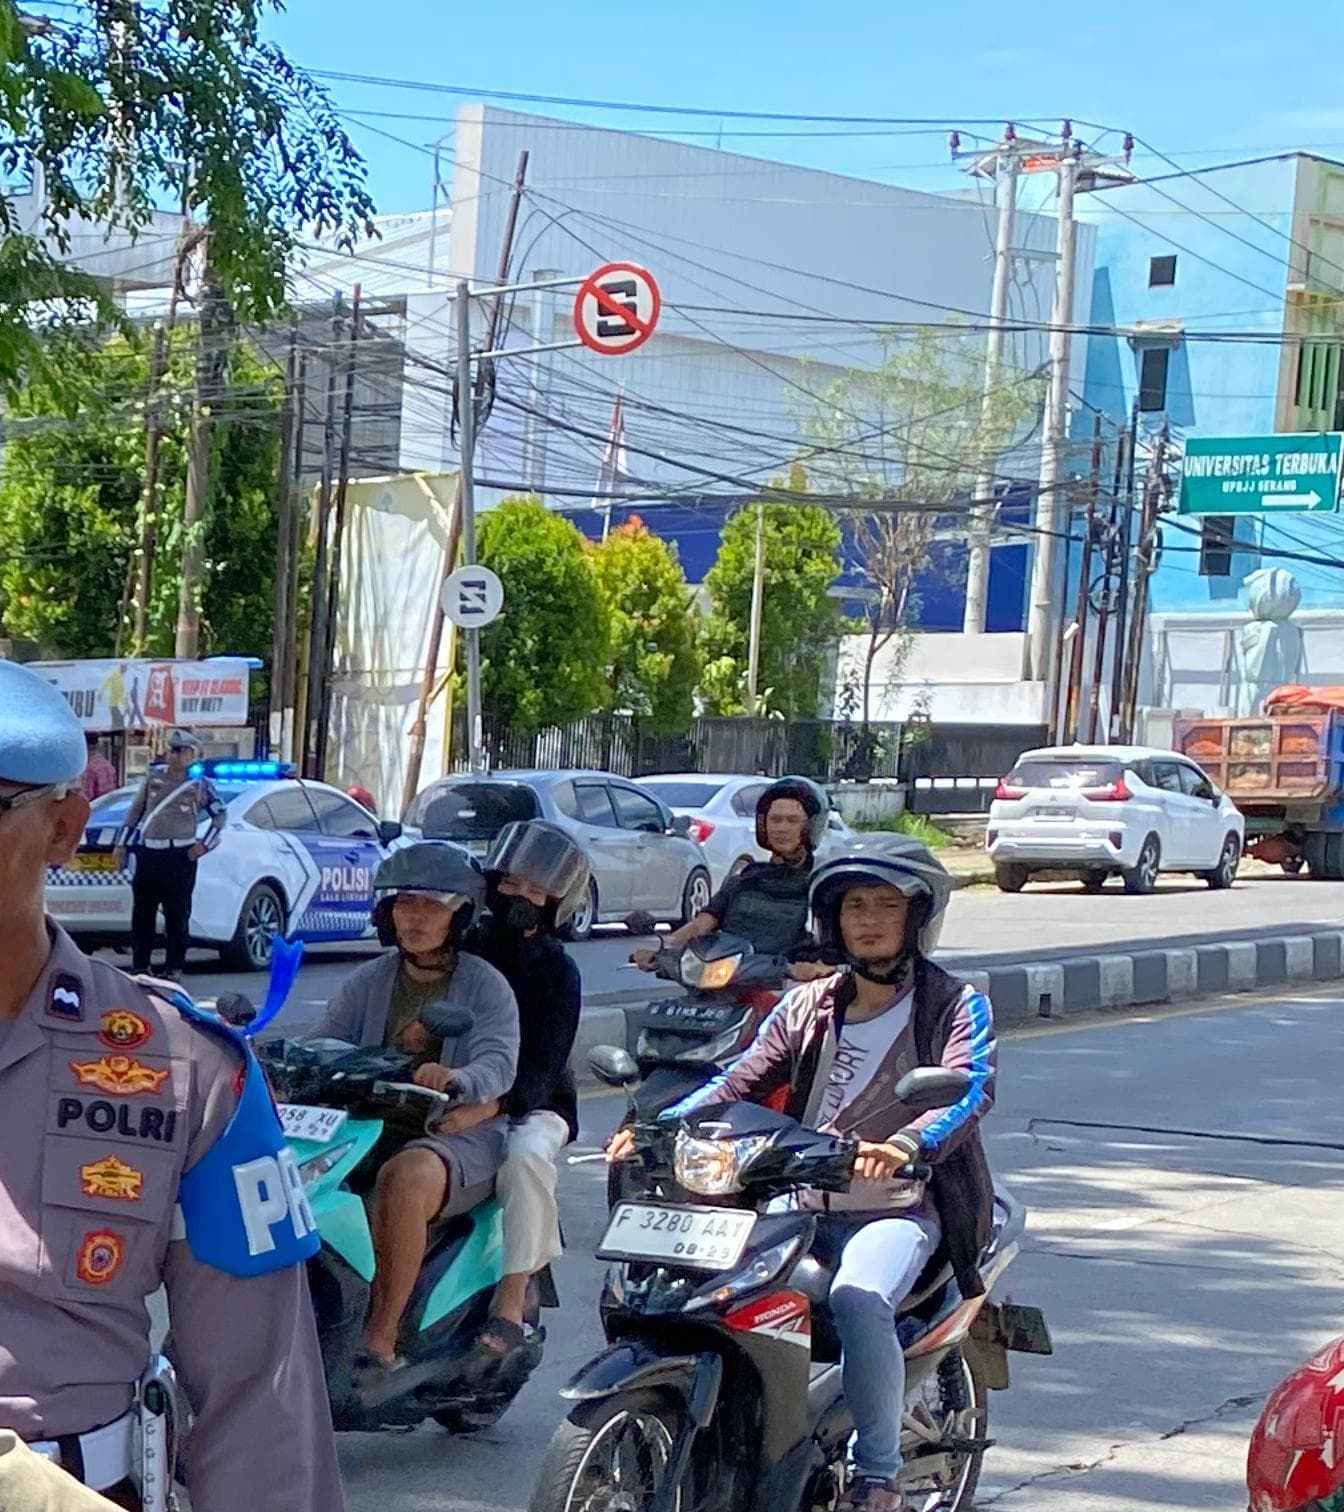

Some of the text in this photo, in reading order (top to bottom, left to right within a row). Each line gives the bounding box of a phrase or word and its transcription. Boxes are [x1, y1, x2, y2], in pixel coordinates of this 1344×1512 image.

[1184, 452, 1337, 477] UNIVERSITAS TERBUKA
[321, 866, 370, 891] POLISI
[825, 1038, 869, 1109] LUXURY
[57, 1097, 177, 1143] POLRI
[616, 1208, 634, 1228] F
[640, 1210, 693, 1233] 3280
[753, 1301, 797, 1324] HONDA
